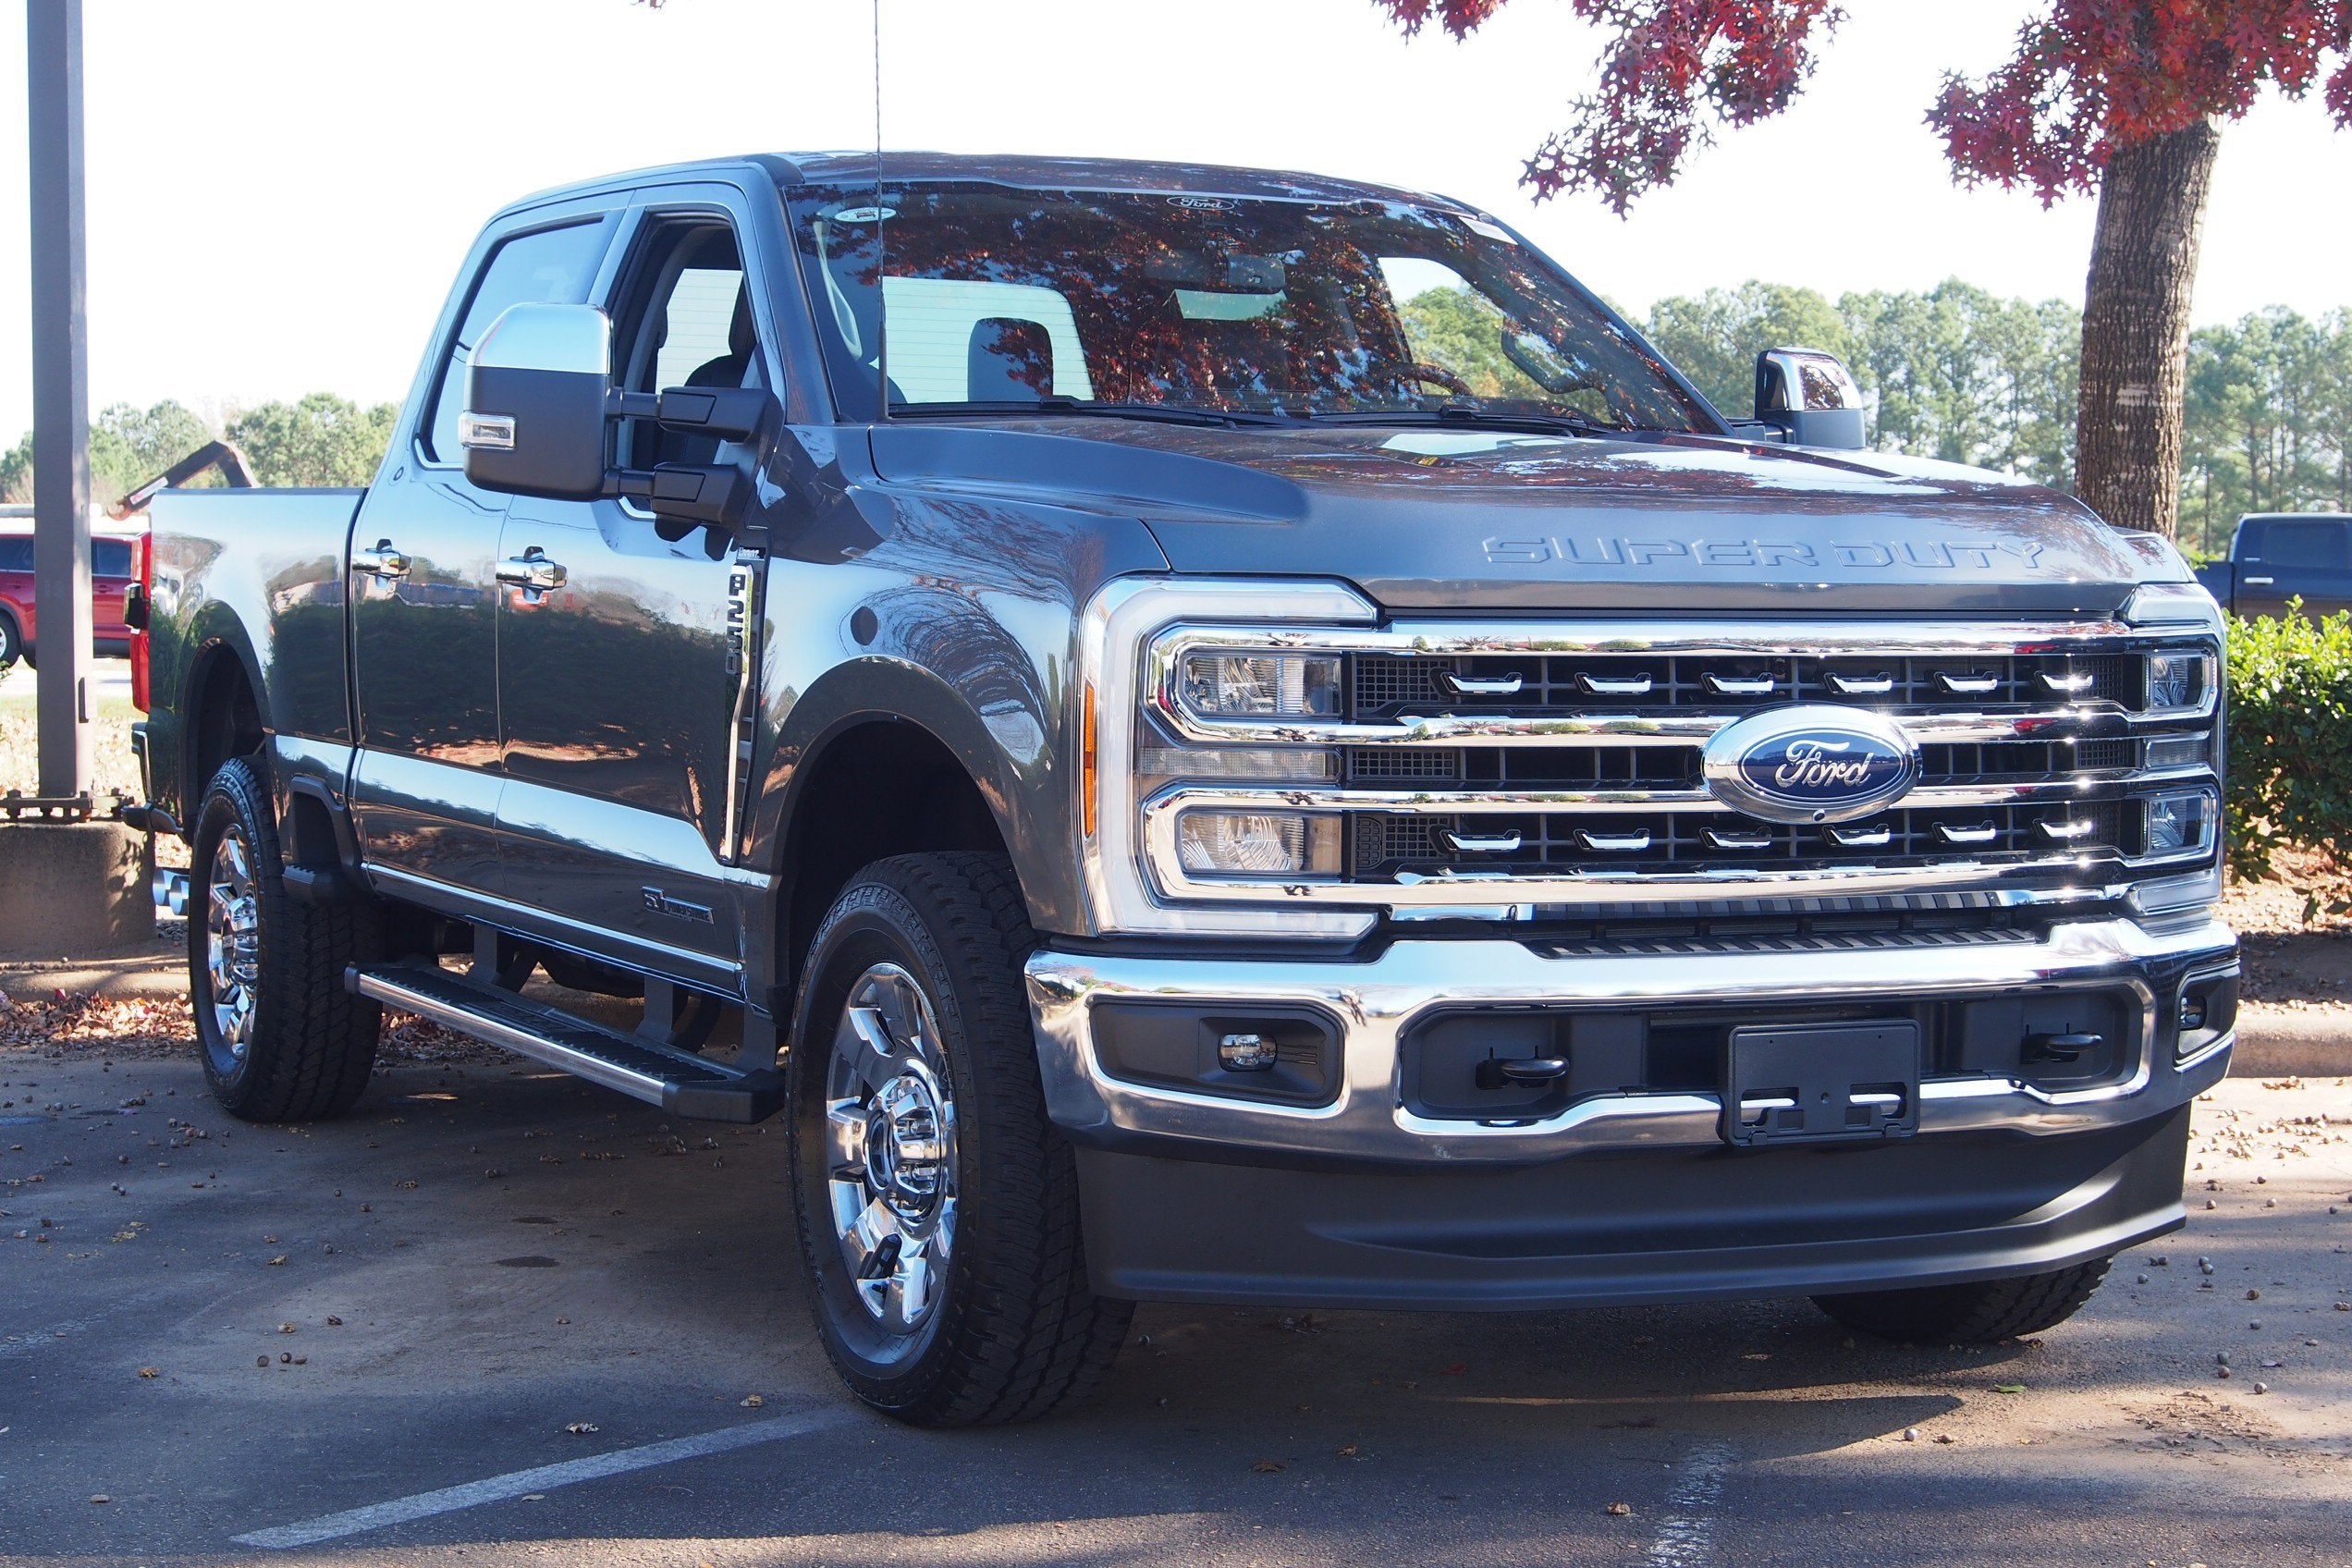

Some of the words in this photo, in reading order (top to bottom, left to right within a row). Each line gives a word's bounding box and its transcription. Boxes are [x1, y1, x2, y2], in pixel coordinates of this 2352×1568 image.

[1180, 197, 1223, 208] Ford
[1481, 535, 1819, 567] SUPER
[1831, 541, 2044, 569] DUTY
[1775, 740, 1874, 788] Ford
